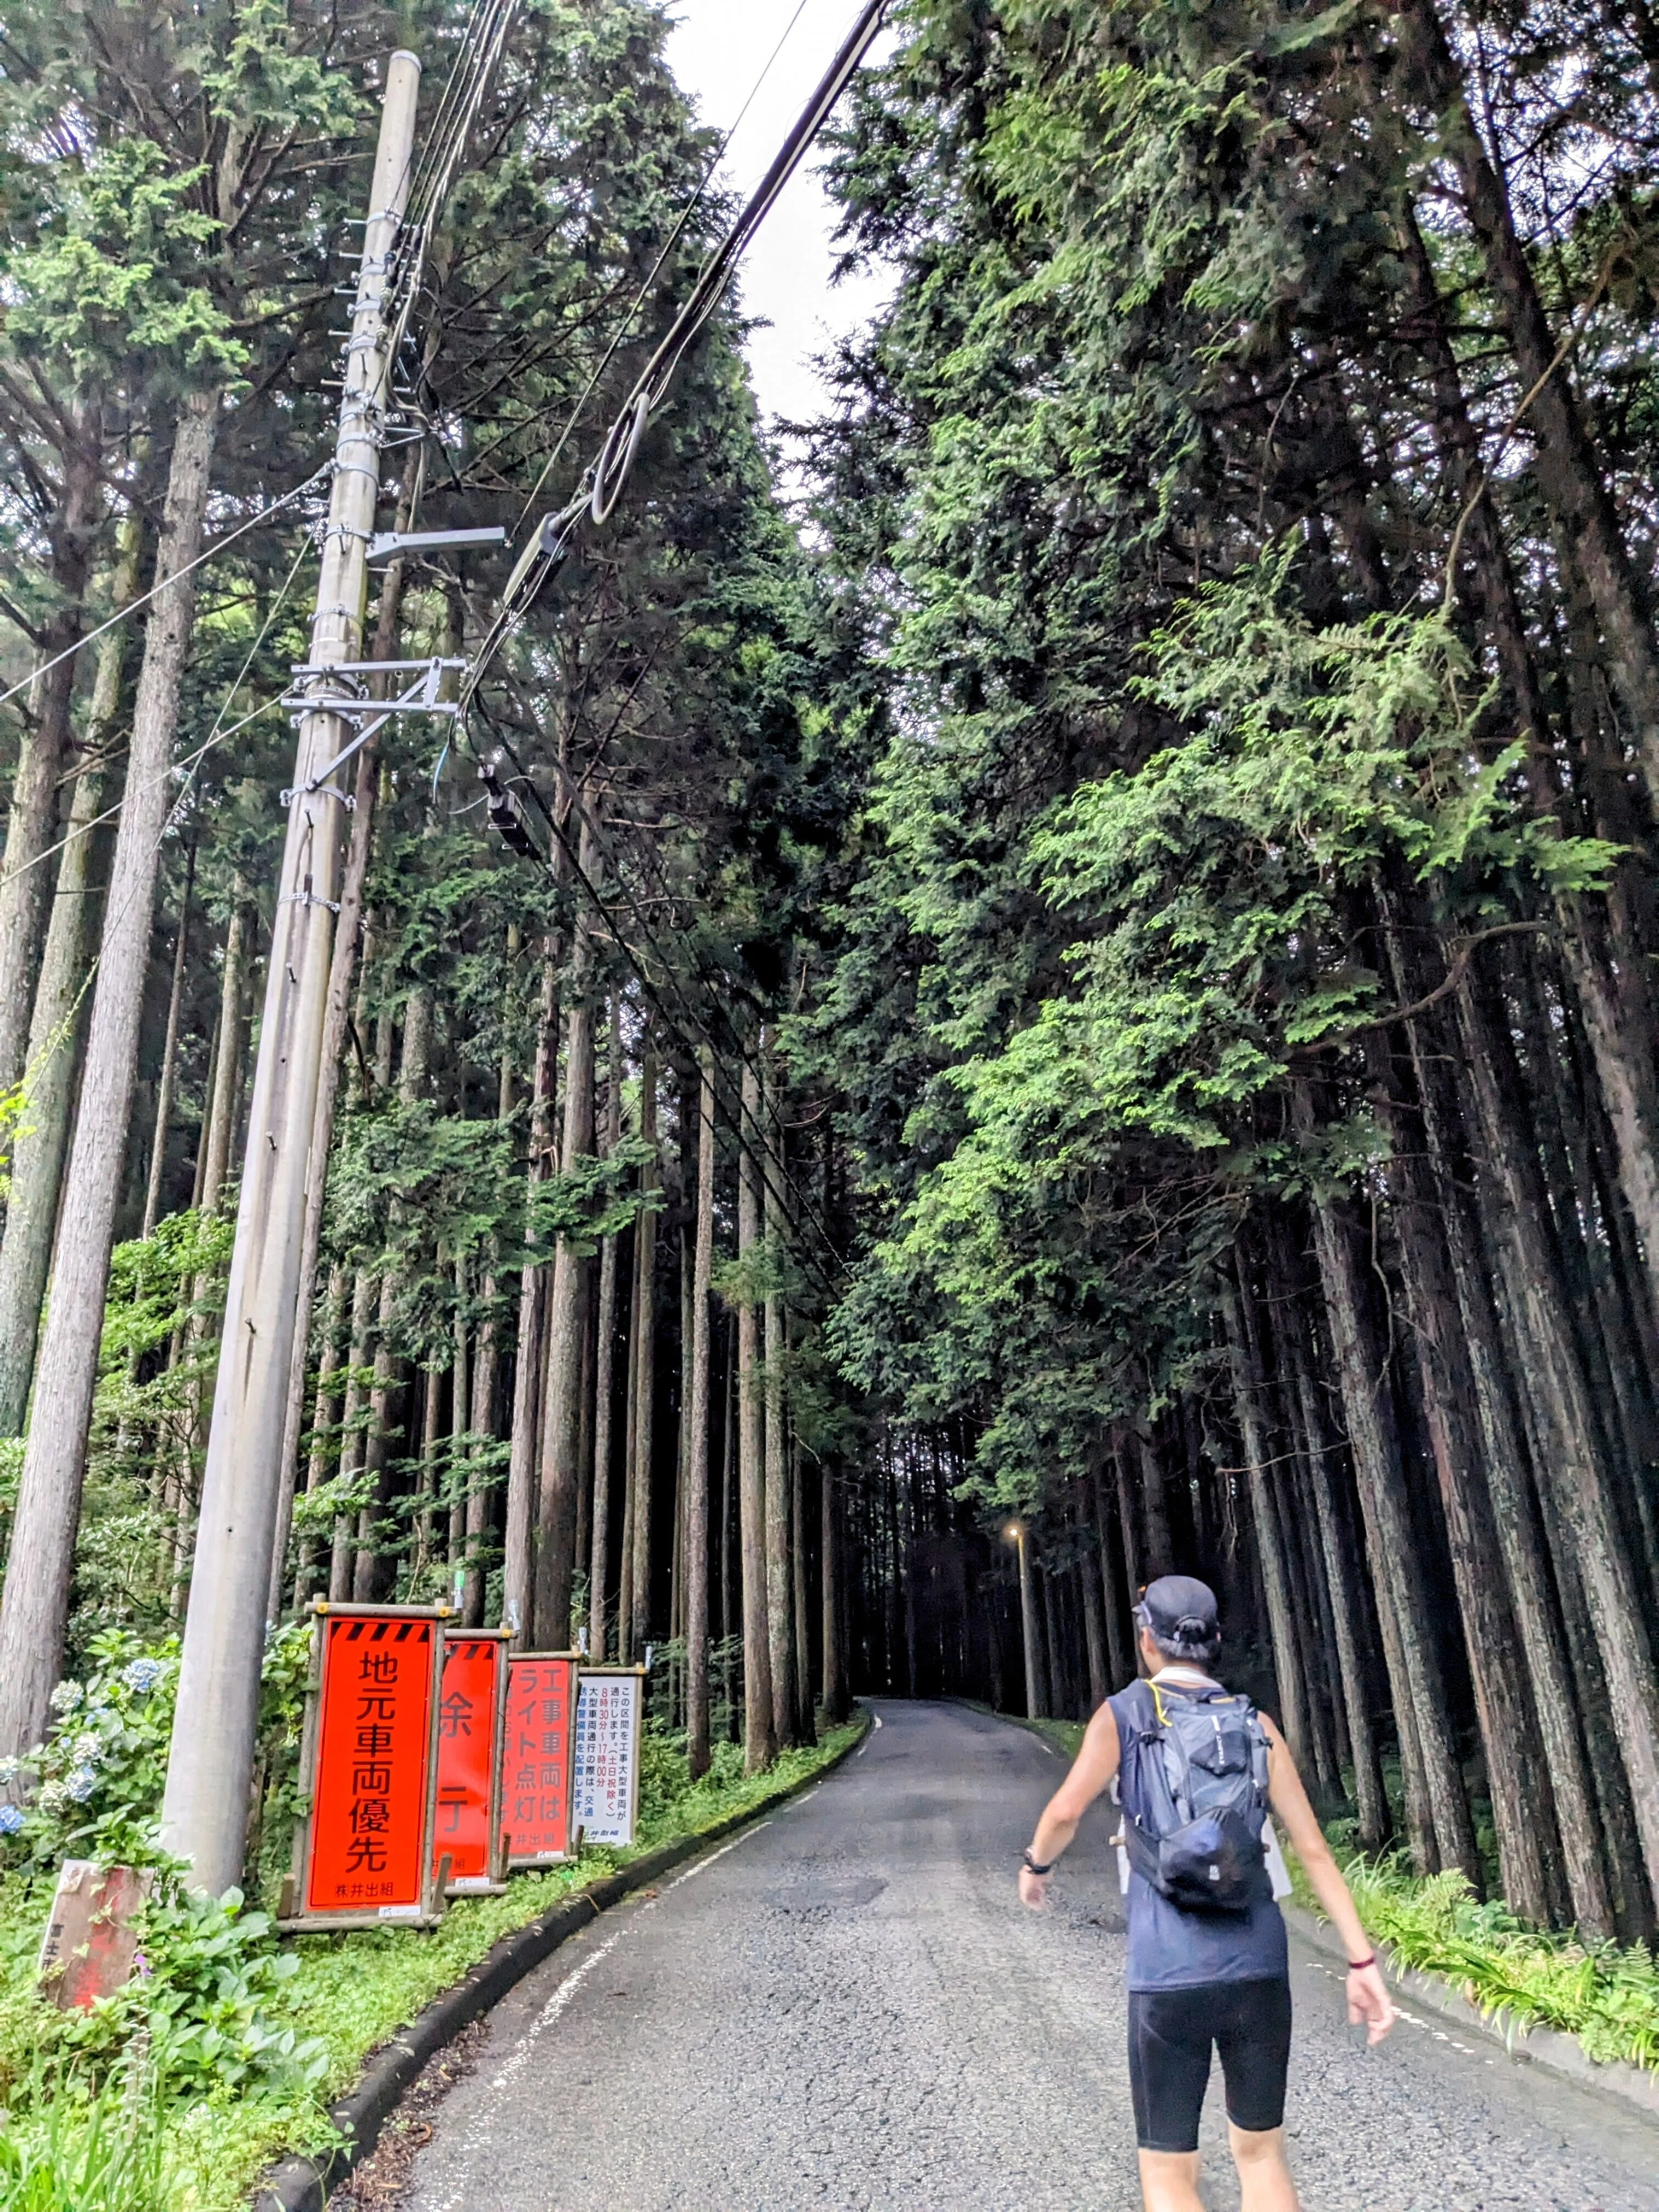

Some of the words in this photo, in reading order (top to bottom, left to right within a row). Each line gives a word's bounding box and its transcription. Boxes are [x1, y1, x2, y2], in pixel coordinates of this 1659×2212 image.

[345, 1651, 398, 1873] 地元車両優先
[514, 1669, 538, 1822] ライト点灯
[540, 1669, 562, 1821] 工事車両は
[584, 1687, 598, 1816] 大型車両通行の際は、交通
[617, 1687, 630, 1820] この区間を工事大型車両が
